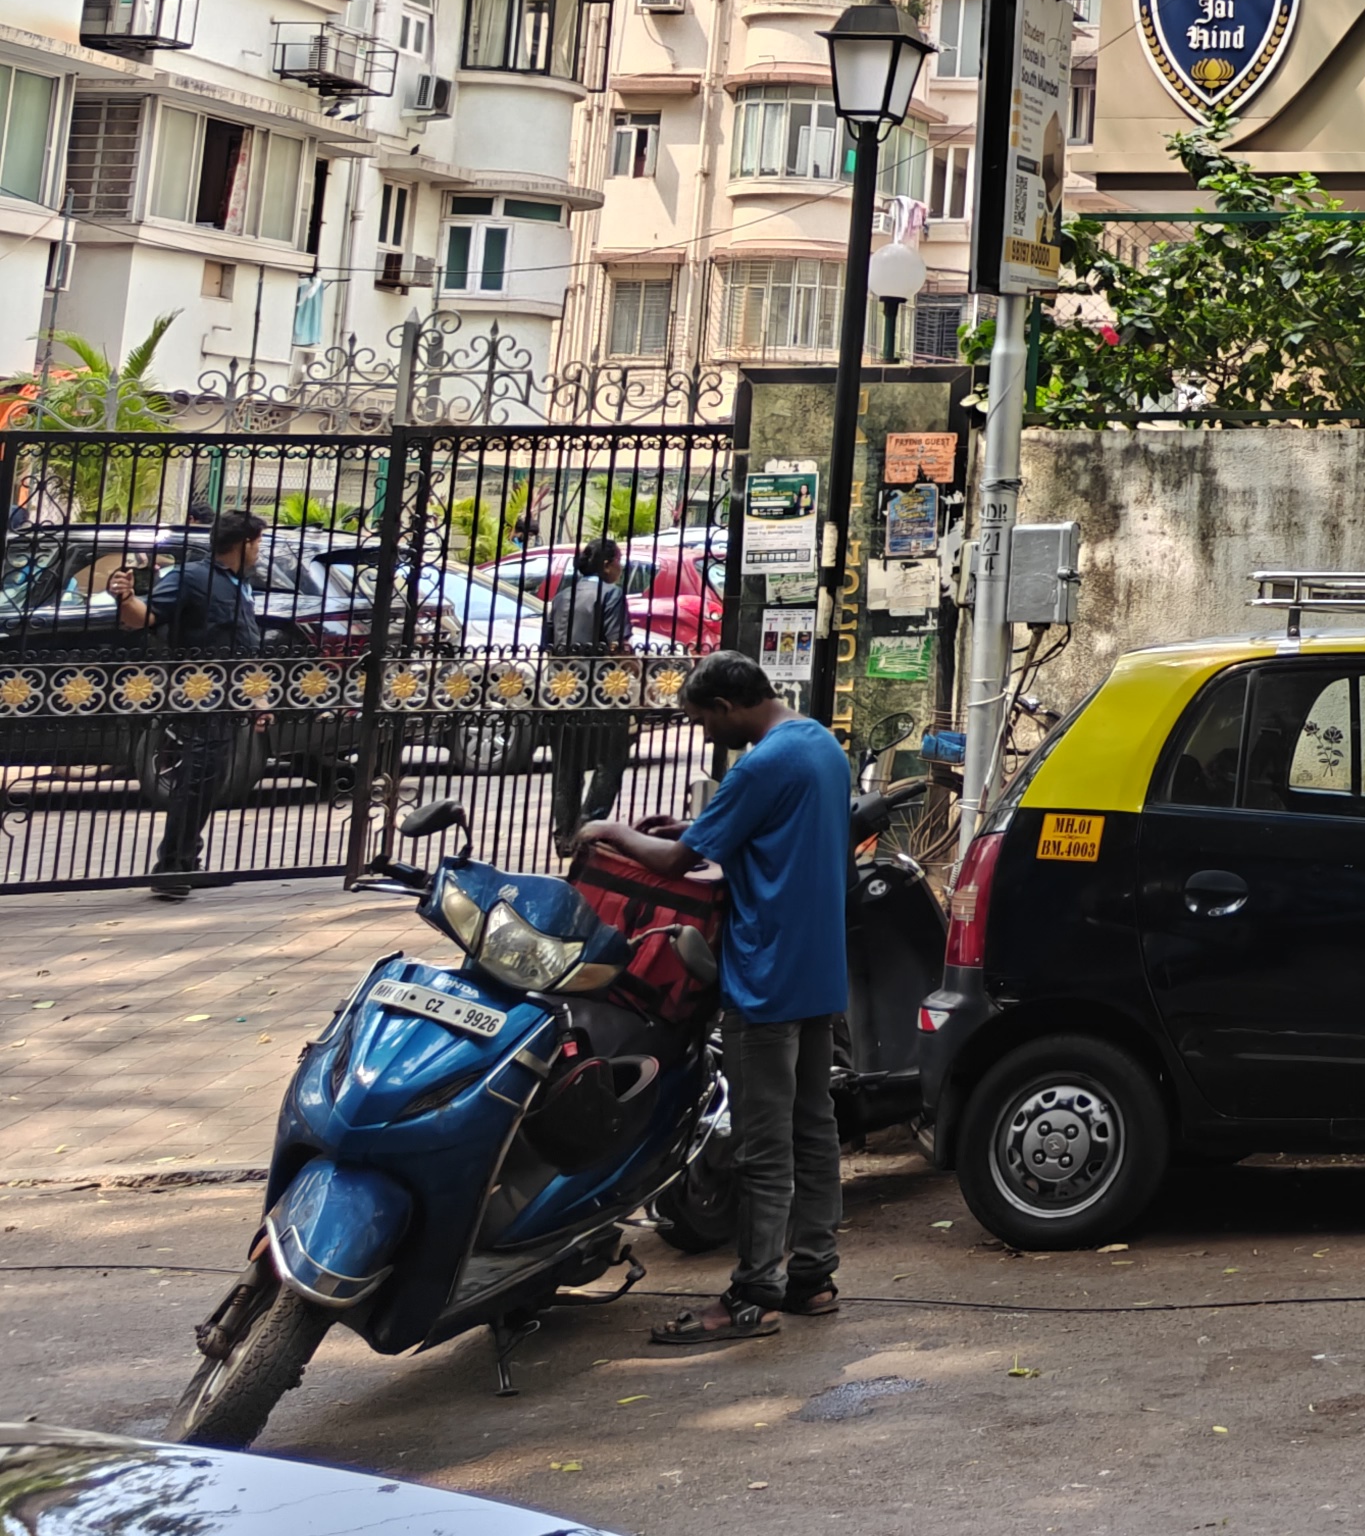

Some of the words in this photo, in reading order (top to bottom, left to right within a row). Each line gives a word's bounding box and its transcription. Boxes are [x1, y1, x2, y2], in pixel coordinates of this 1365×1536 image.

[1186, 24, 1246, 50] Hind
[1053, 817, 1092, 835] MH.01
[1041, 840, 1096, 858] BM.4003
[425, 997, 446, 1014] CZ
[463, 1008, 500, 1034] 9926
